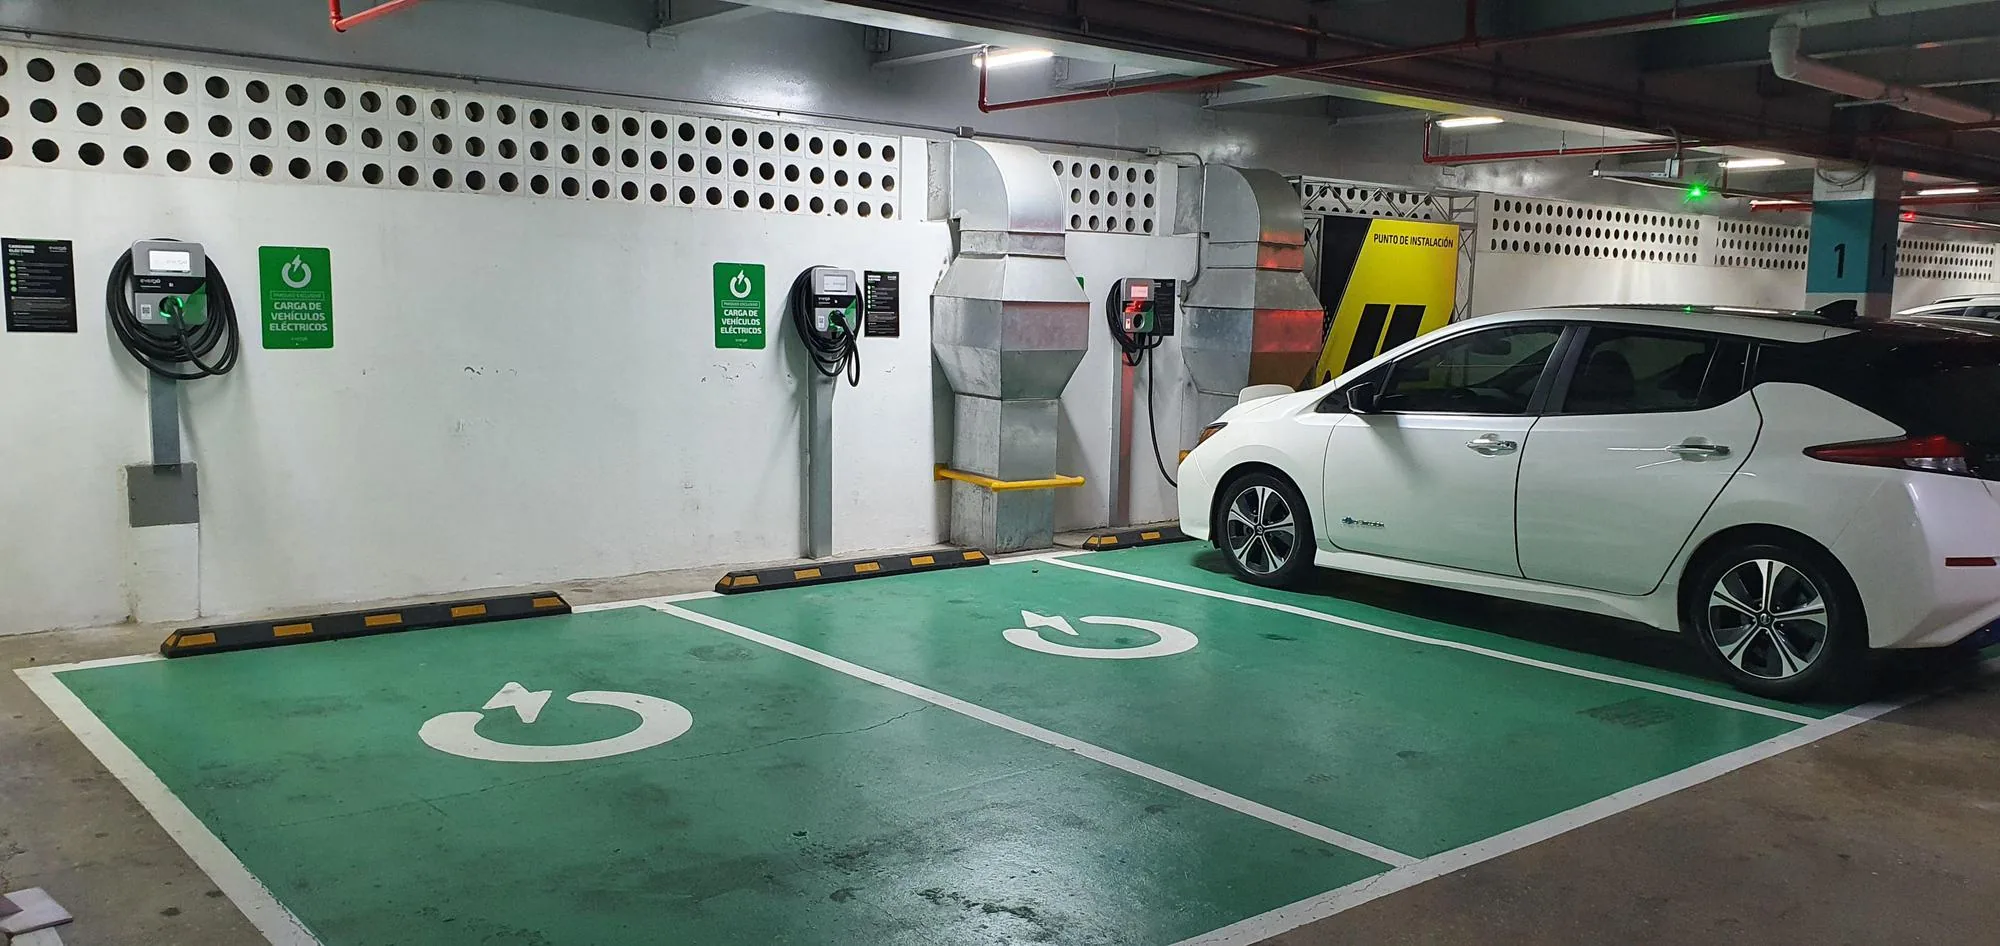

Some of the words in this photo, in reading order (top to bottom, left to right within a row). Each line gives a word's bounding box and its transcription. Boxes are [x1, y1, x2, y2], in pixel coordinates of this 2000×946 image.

[1374, 233, 1398, 244] PUNTO
[1399, 235, 1409, 245] DE
[1410, 236, 1454, 248] INSTALACIÓN
[1834, 243, 1846, 279] 1
[274, 302, 307, 310] CARGA
[308, 302, 322, 310] DE
[271, 310, 326, 321] VEHÍCULOS
[721, 316, 761, 325] VEHÍCULOS
[269, 321, 328, 331] ELÉCTRICOS
[720, 325, 762, 334] ELÉCTRICOS
